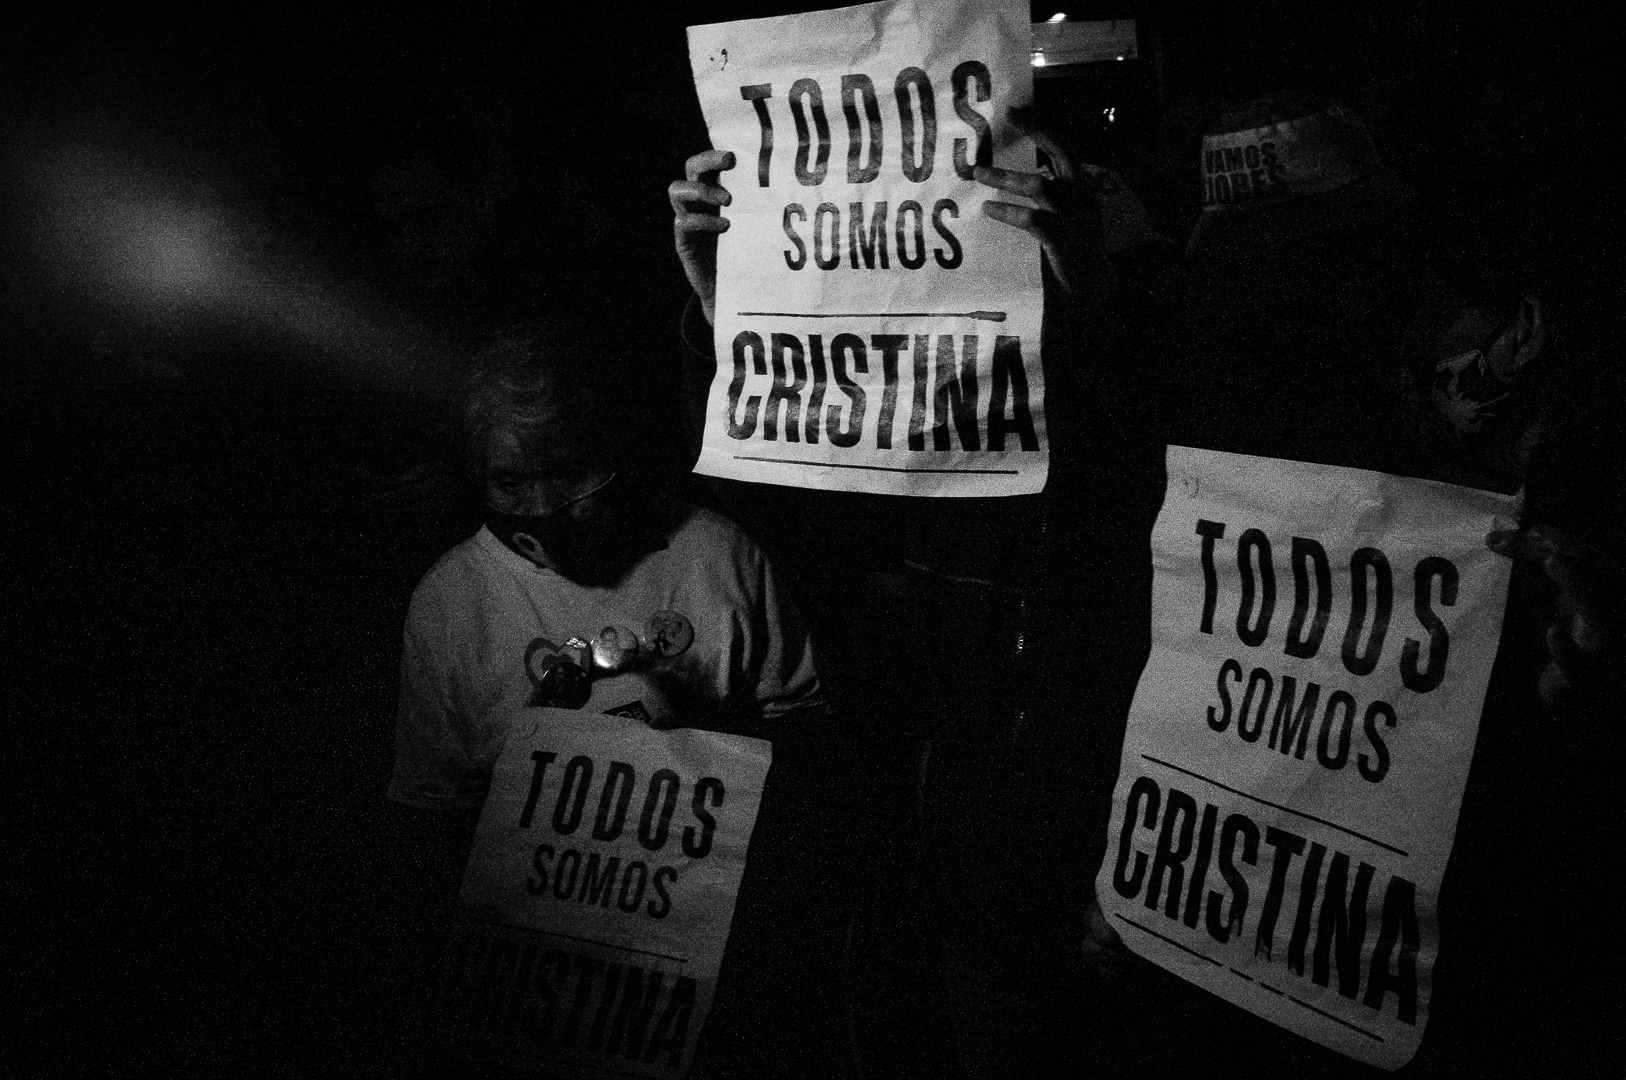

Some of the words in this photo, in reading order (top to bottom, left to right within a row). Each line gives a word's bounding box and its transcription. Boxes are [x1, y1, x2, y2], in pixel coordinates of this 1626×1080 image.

[740, 60, 993, 188] TODOS
[783, 198, 963, 271] SOMOS
[724, 330, 1040, 452] CRISTINA
[1195, 519, 1460, 694] TODOS
[1207, 658, 1397, 784] SOMOS
[519, 750, 725, 859] TODOS
[526, 844, 677, 919] SOMOS
[1113, 776, 1421, 1026] CRISTINA
